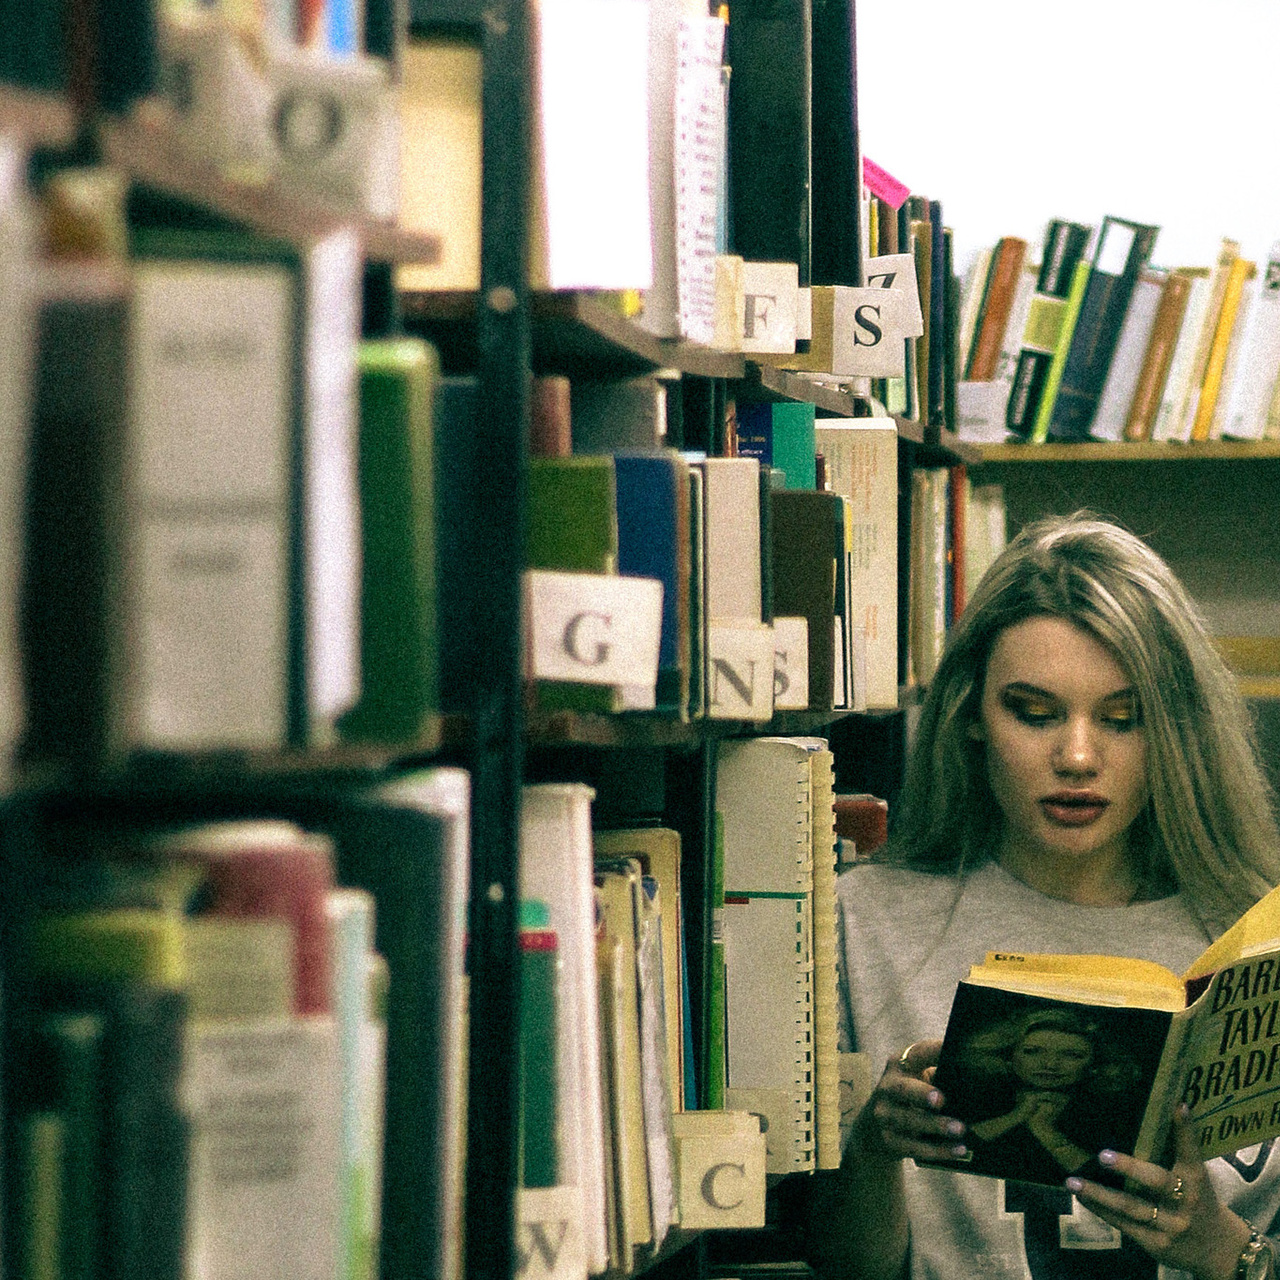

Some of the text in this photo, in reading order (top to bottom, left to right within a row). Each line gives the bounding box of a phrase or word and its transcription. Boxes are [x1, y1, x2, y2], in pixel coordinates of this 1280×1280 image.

[853, 304, 882, 347] S
[563, 610, 612, 666] G
[711, 657, 756, 707] N
[1219, 1109, 1265, 1141] OWN
[701, 1162, 746, 1210] C
